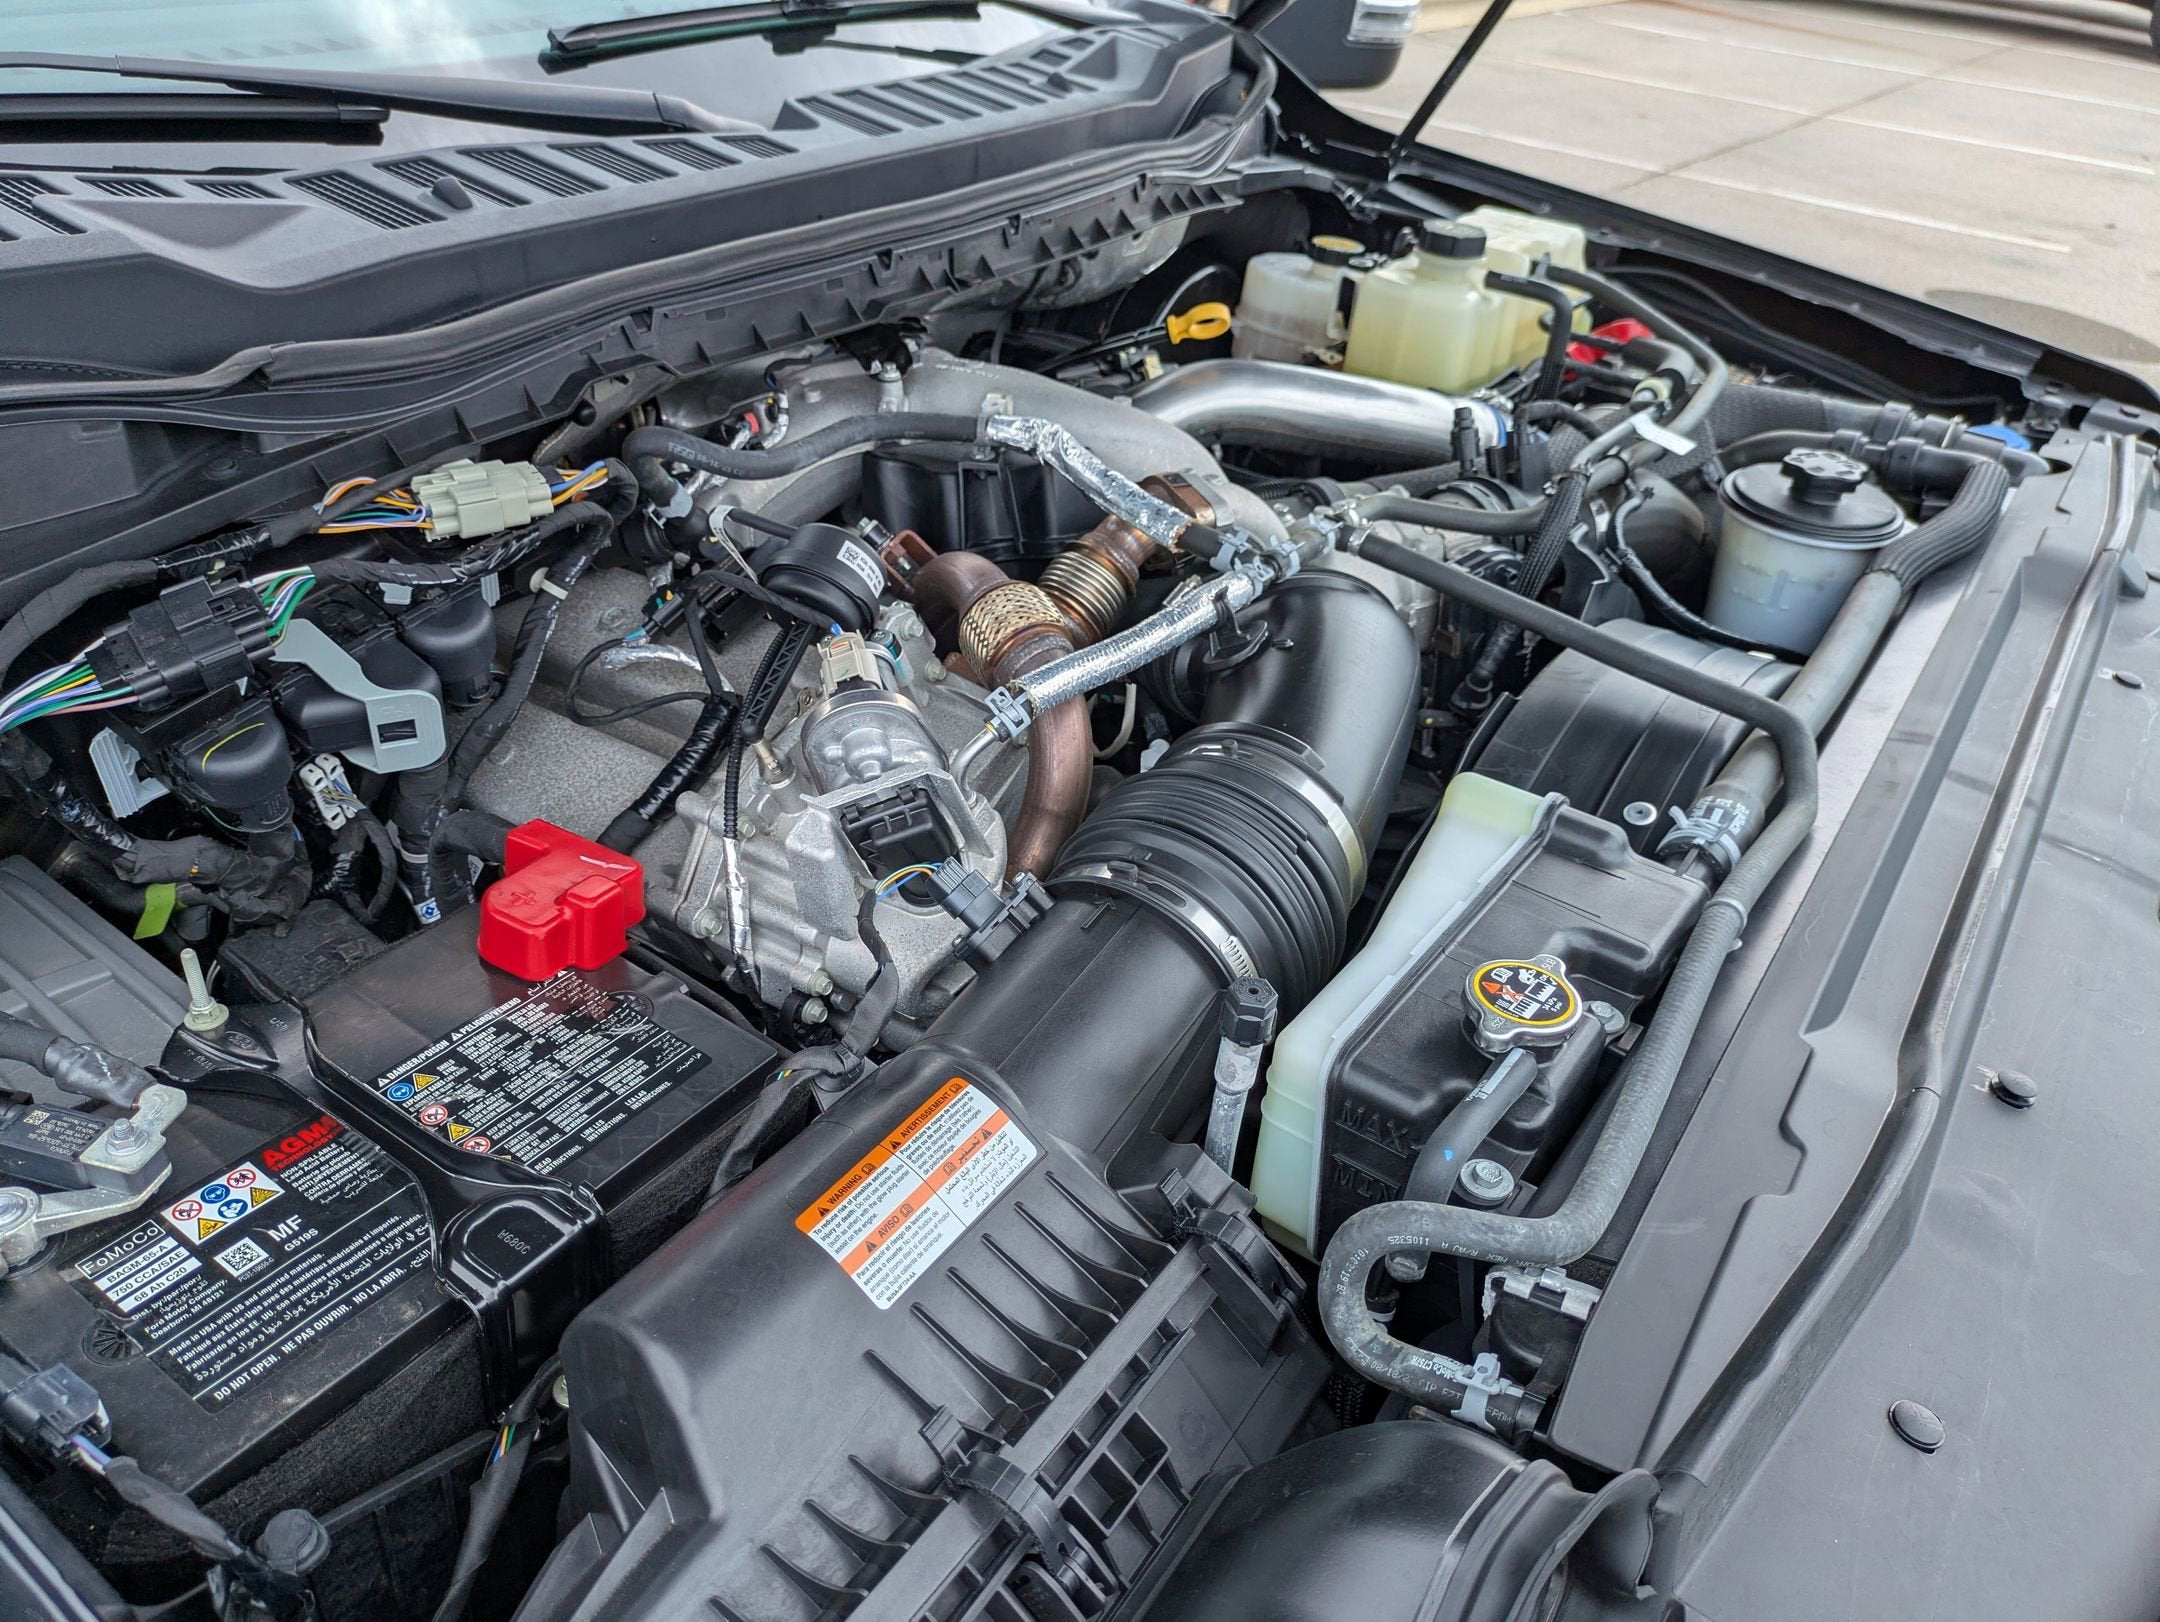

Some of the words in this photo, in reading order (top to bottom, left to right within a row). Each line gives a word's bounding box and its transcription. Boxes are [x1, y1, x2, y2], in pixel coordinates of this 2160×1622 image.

[383, 1039, 452, 1079] DANGER/POISON
[457, 996, 523, 1034] PELIGRO/VENENO
[623, 1096, 638, 1106] LEA
[632, 1089, 648, 1099] LAS
[899, 1090, 951, 1138] AVERTISSEMENT
[899, 1143, 912, 1155] Pour
[909, 1128, 927, 1145] réduire
[929, 1112, 945, 1127] risque
[948, 1089, 970, 1109] blessures
[256, 1119, 330, 1168] AGM
[578, 1126, 597, 1138] LIRE
[590, 1119, 607, 1129] LES
[905, 1144, 922, 1161] graves
[919, 1138, 928, 1146] ou
[925, 1132, 934, 1140] de
[959, 1100, 969, 1110] pas
[1341, 1100, 1409, 1153] MAX
[270, 1132, 335, 1173] TECHNOLOGY
[279, 1141, 338, 1179] NON-SPILLABLE
[284, 1169, 304, 1183] Lead
[302, 1159, 320, 1171] Acid
[318, 1144, 345, 1163] Battery
[291, 1168, 320, 1188] Batterie
[318, 1162, 330, 1171] au
[327, 1149, 352, 1166] plomb
[532, 1157, 553, 1170] READ
[302, 1177, 332, 1197] CONTRA
[813, 1227, 822, 1236] To
[820, 1212, 838, 1229] reduce
[837, 1203, 848, 1214] risk
[845, 1198, 853, 1206] of
[851, 1180, 873, 1201] possible
[870, 1165, 889, 1183] serious
[826, 1172, 862, 1206] WARNING
[827, 1233, 842, 1248] (such
[839, 1227, 848, 1236] as
[845, 1215, 862, 1231] ether)
[858, 1206, 870, 1217] with
[867, 1199, 877, 1209] the
[875, 1190, 889, 1203] glow
[885, 1181, 898, 1193] plug
[894, 1168, 910, 1184] starter
[834, 1220, 842, 1229] or
[839, 1206, 857, 1223] death:
[854, 1199, 864, 1209] Do
[861, 1193, 871, 1203] not
[869, 1185, 879, 1196] use
[877, 1172, 893, 1188] starter
[80, 1223, 160, 1275] FoMoCo
[267, 1213, 307, 1243] MF
[283, 1226, 320, 1253] G519S
[833, 1239, 849, 1254] assist
[846, 1233, 855, 1241] on
[853, 1226, 863, 1236] the
[855, 1265, 869, 1279] Para
[867, 1248, 886, 1268] reducir
[883, 1243, 891, 1251] el
[888, 1229, 907, 1247] riesgo
[903, 1223, 912, 1232] de
[909, 1204, 930, 1226] lesiones
[862, 1265, 883, 1286] severas
[884, 1244, 904, 1264] muerte:
[902, 1236, 911, 1246] No
[909, 1228, 919, 1239] use
[917, 1215, 933, 1231] fluidos
[930, 1209, 939, 1217] de
[876, 1214, 900, 1238] AVISO
[1388, 1236, 1430, 1246] 1105325
[105, 1243, 169, 1283] BAGM-65-A
[111, 1281, 135, 1298] 750
[132, 1249, 185, 1284] CCA/SAE
[868, 1271, 891, 1294] arranque
[888, 1257, 905, 1274] (como
[916, 1226, 934, 1245] arranca
[936, 1210, 951, 1225] motor
[874, 1289, 886, 1301] con
[915, 1249, 924, 1259] de
[132, 1290, 149, 1302] 68
[147, 1279, 166, 1293] Ah
[164, 1265, 188, 1283] C20
[176, 1338, 213, 1365] Fabriqué
[209, 1328, 226, 1342] aux
[223, 1302, 263, 1332] États-Unis
[260, 1291, 281, 1307] avec
[277, 1283, 294, 1295] des
[291, 1260, 328, 1287] matériaux
[326, 1237, 364, 1265] américains
[361, 1232, 372, 1241] et
[369, 1212, 402, 1237] importés.
[225, 1334, 238, 1345] en
[235, 1325, 250, 1338] los
[247, 1317, 263, 1330] EE.
[260, 1307, 277, 1321] UU.
[275, 1298, 291, 1311] con
[288, 1273, 327, 1302] materiales
[325, 1237, 382, 1279] estadounidenses
[384, 1210, 424, 1240] importados.
[130, 1305, 153, 1322] Dist.
[143, 1317, 165, 1333] Ford
[163, 1302, 189, 1320] Motor
[187, 1276, 229, 1306] Company,
[150, 1310, 192, 1340] Dearborn,
[189, 1303, 203, 1313] MI
[200, 1288, 225, 1307] 48121
[168, 1338, 192, 1356] Made
[189, 1332, 201, 1342] in
[198, 1321, 217, 1336] USA
[214, 1310, 234, 1325] with
[231, 1303, 245, 1314] US
[242, 1293, 259, 1306] and
[256, 1272, 291, 1297] imported
[288, 1250, 325, 1277] materials.
[213, 1385, 232, 1401] DO
[228, 1370, 252, 1390] NOT
[249, 1350, 282, 1376] OPEN.
[280, 1339, 298, 1354] NE
[294, 1326, 316, 1345] PAS
[312, 1300, 353, 1332] OUVRIR.
[351, 1290, 368, 1304] NO
[365, 1282, 381, 1295] LA
[377, 1263, 407, 1287] ABRA.
